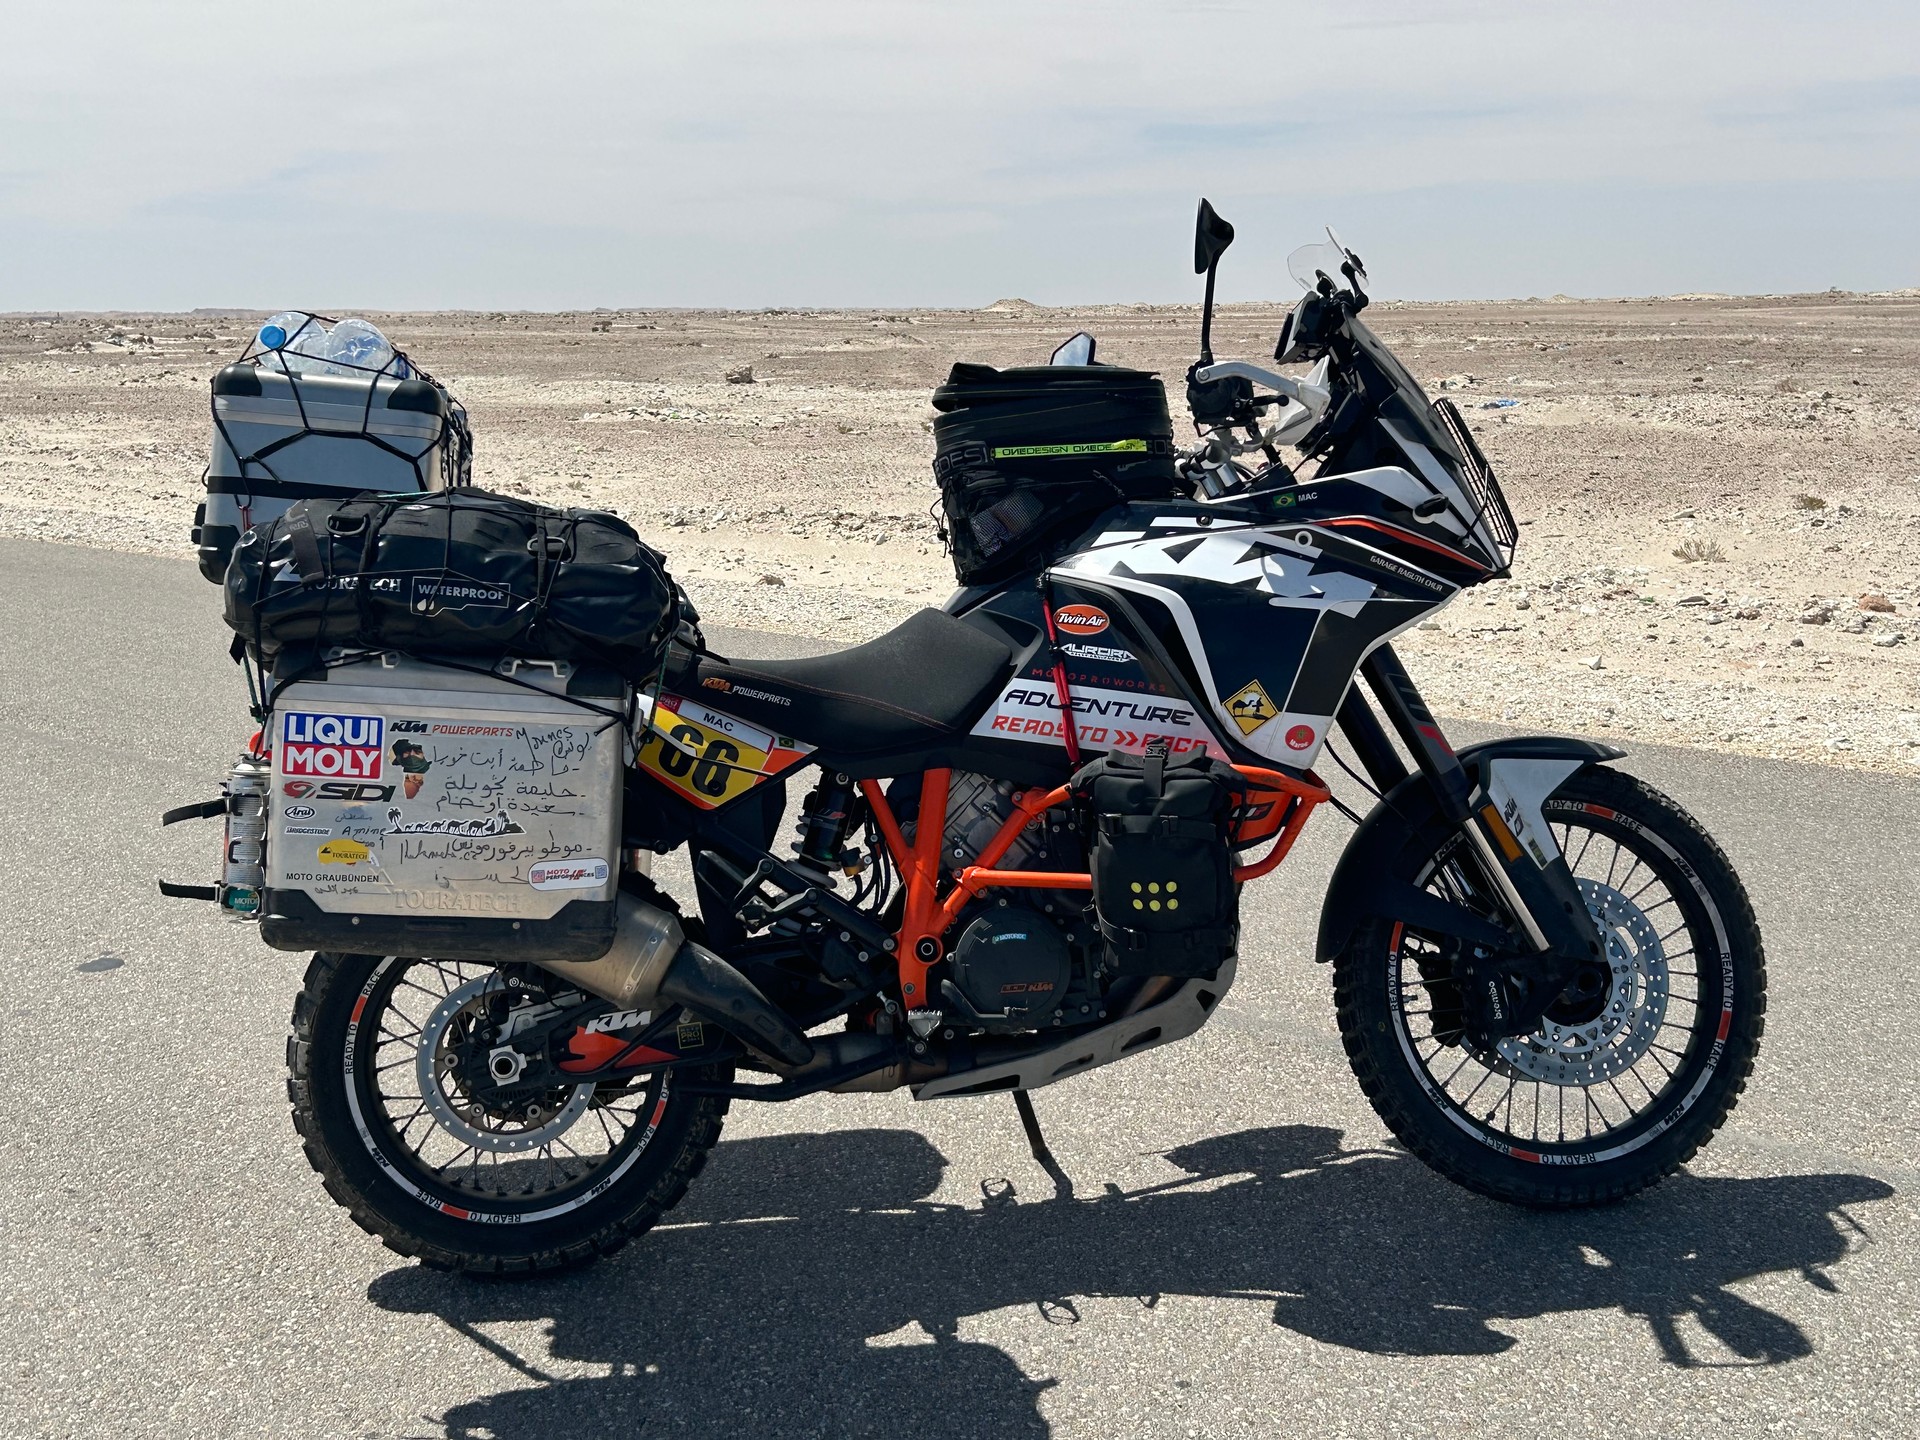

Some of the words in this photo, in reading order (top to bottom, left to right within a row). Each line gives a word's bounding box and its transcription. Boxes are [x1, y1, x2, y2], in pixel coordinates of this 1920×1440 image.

[1002, 446, 1069, 456] ONEDESIGN
[1298, 492, 1318, 502] MAC
[1370, 555, 1398, 572] GARAGE
[1397, 567, 1425, 584] RAGUTH
[1425, 580, 1443, 592] CHUR
[418, 584, 505, 600] WATERPROOF
[1057, 612, 1086, 624] Twin
[1086, 614, 1105, 626] Air
[1060, 643, 1138, 660] AURORA
[1031, 668, 1167, 692] MOOPROWORKS
[701, 677, 731, 691] KTM
[732, 685, 792, 706] POWERPARTS
[1004, 689, 1194, 726] ADVENTURE
[288, 715, 379, 746] LIQUI
[390, 720, 428, 734] KTM
[432, 724, 514, 737] POWERPARTS
[703, 712, 734, 732] MAC
[1079, 725, 1109, 743] TO
[286, 746, 380, 776] MOLY
[658, 724, 740, 797] 66
[316, 783, 396, 802] SIDI
[287, 806, 311, 816] Arai
[1570, 801, 1584, 810] TO
[286, 827, 330, 835] BRIDGESTONE
[342, 826, 387, 836] Amine
[1614, 813, 1643, 833] RACE
[286, 872, 313, 881] MOTO
[315, 873, 379, 883] GRAUBÜNDEN
[394, 889, 521, 912] TOURATECH
[1388, 954, 1397, 972] TO
[1720, 952, 1734, 993] READY
[362, 970, 383, 995] RACE
[1387, 974, 1399, 1012] READY
[1489, 981, 1503, 1020] brembo
[1722, 993, 1734, 1009] TO
[348, 1023, 357, 1037] TO
[585, 1009, 651, 1035] KTM
[345, 1039, 355, 1074] READY
[1705, 1041, 1725, 1071] RACE
[636, 1126, 654, 1152] RACE
[1482, 1133, 1509, 1153] RACE
[1542, 1154, 1558, 1164] TO
[1558, 1153, 1596, 1165] READY
[415, 1189, 443, 1209] RACE
[470, 1212, 487, 1221] TO
[487, 1213, 521, 1223] READY
